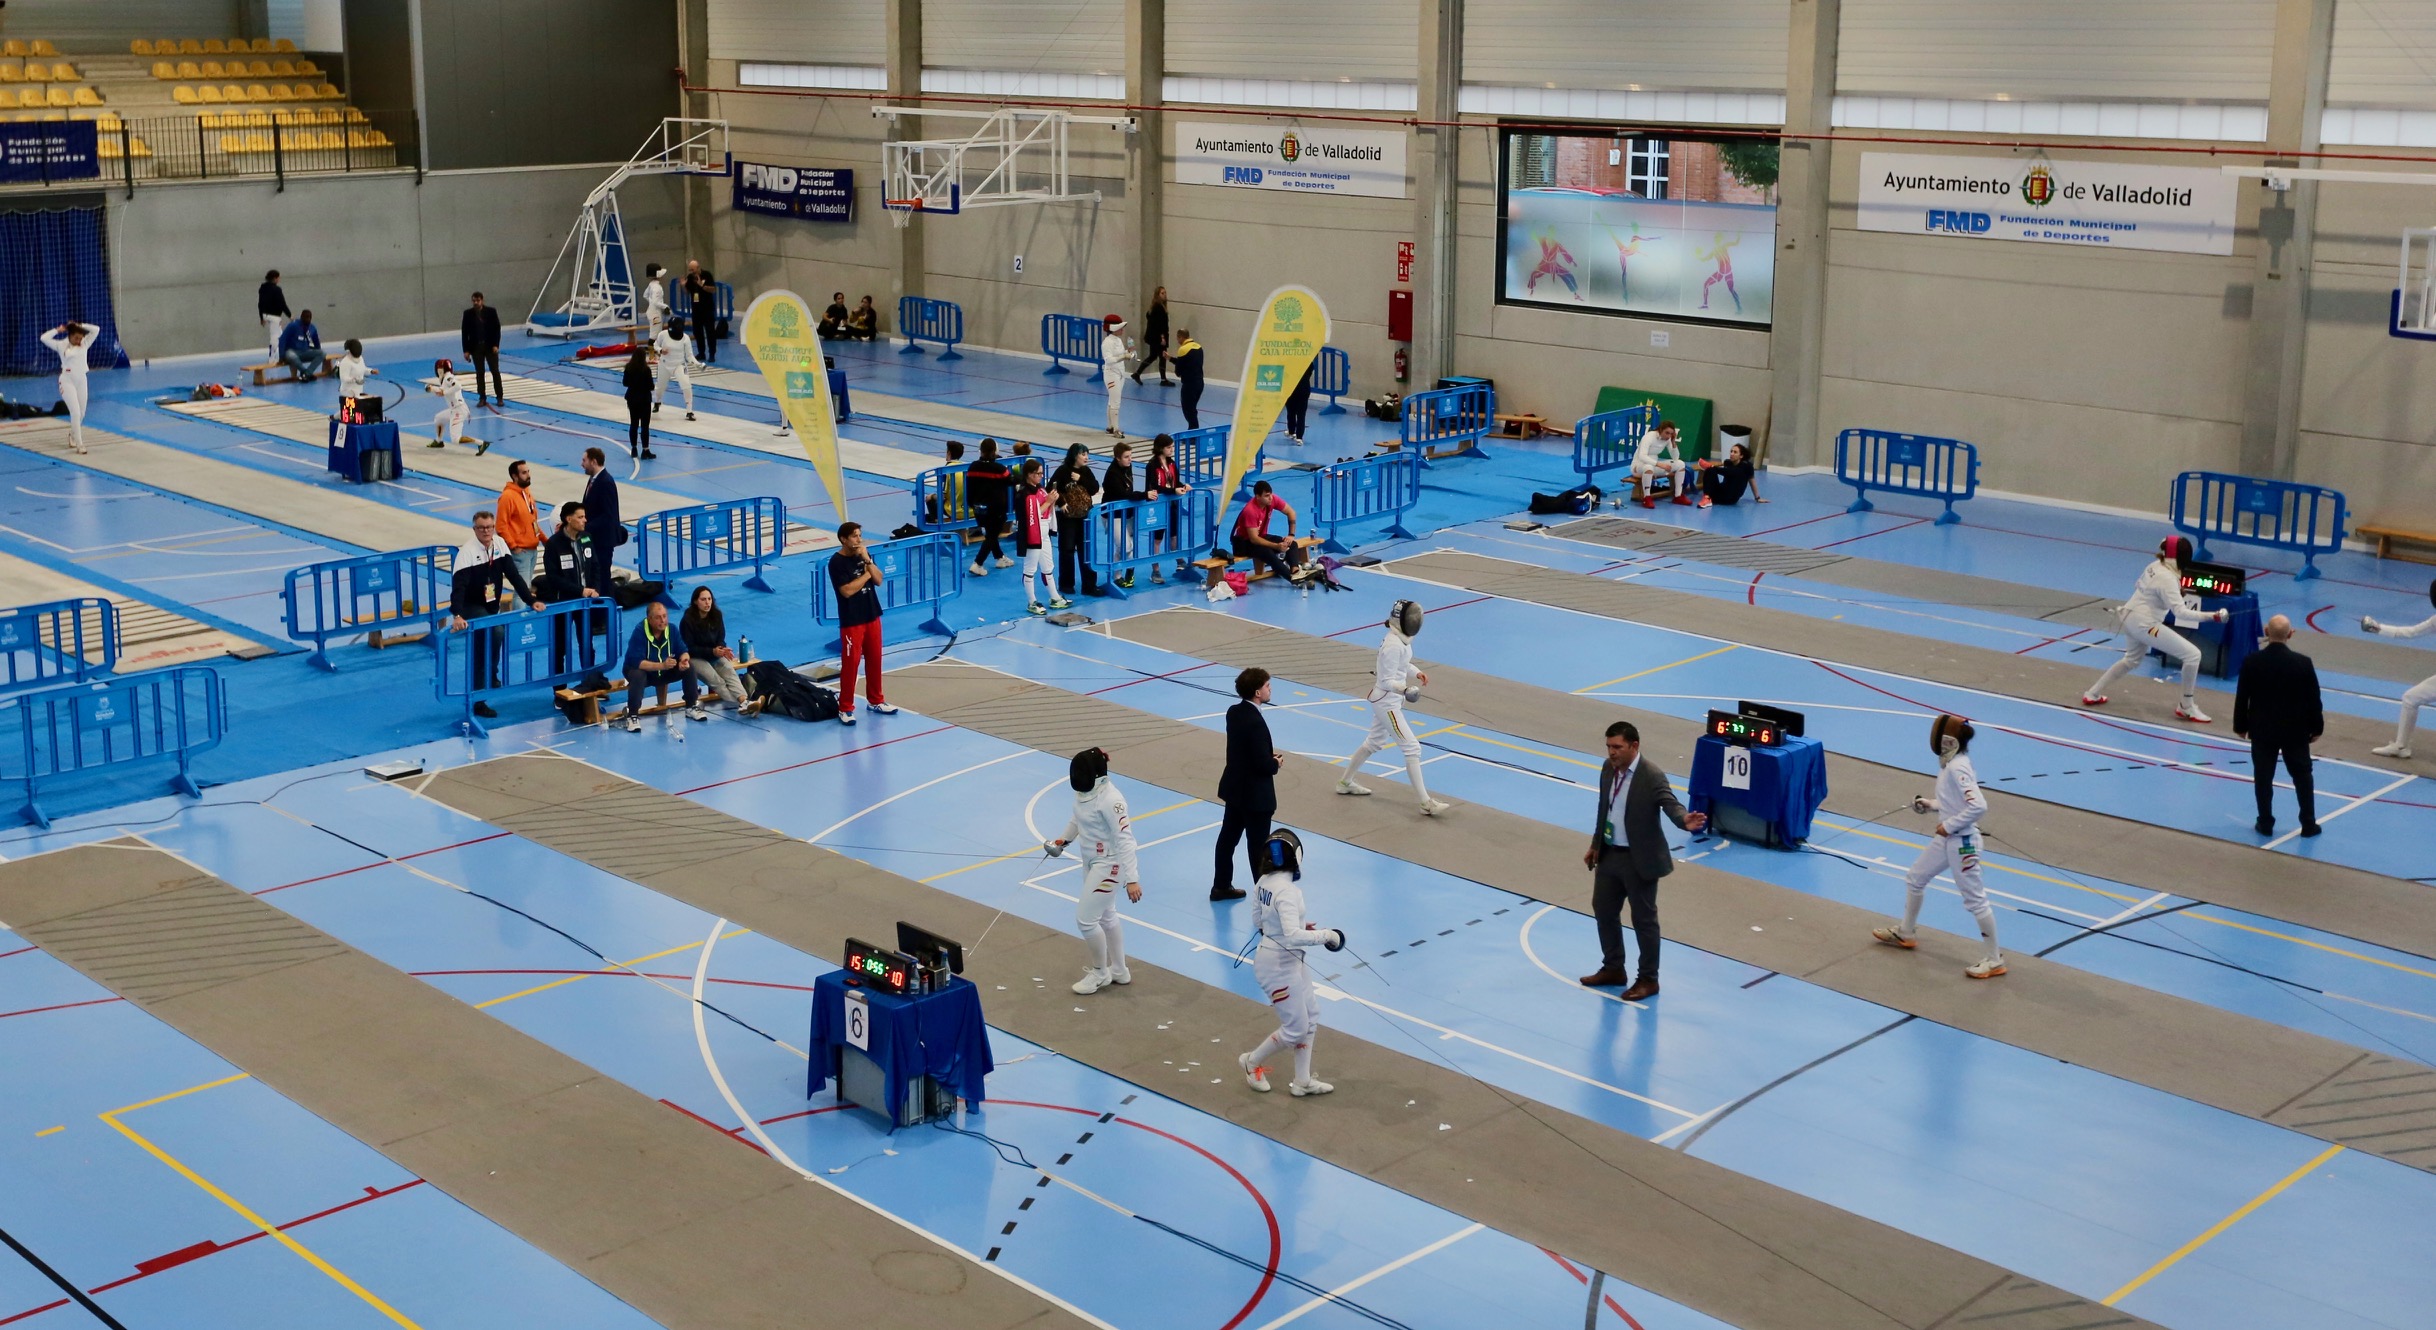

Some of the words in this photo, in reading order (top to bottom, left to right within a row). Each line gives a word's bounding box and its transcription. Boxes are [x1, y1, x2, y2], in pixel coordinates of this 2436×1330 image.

[1195, 137, 1274, 155] Ayuntamiento
[1304, 143, 1319, 157] de
[1322, 144, 1382, 161] Valladolid
[742, 163, 798, 193] FMD
[800, 178, 834, 187] Municipal
[801, 169, 835, 177] Fundación
[1223, 166, 1263, 185] FMD
[1267, 169, 1307, 178] Fundación
[1310, 172, 1351, 181] Municipal
[1294, 181, 1335, 190] Deportes
[1883, 171, 2011, 194] Ayuntamiento
[2063, 182, 2086, 200] de
[2092, 183, 2192, 206] Valladolid
[743, 196, 787, 211] Ayuntamiento
[811, 203, 846, 214] Valladolid
[1925, 209, 1992, 234] FMD
[1999, 215, 2065, 227] Fundación
[2069, 219, 2137, 232] Municipal
[2022, 229, 2040, 238] de
[2042, 230, 2111, 243] Deportes
[1015, 258, 1022, 271] 2
[1260, 348, 1280, 356] CAJA
[1282, 348, 1310, 356] RURAL
[1717, 721, 1725, 734] 6
[1761, 730, 1770, 743] 6
[1727, 755, 1748, 777] 10
[851, 955, 861, 970] 15
[891, 970, 903, 987] 10
[851, 1007, 863, 1039] 6
